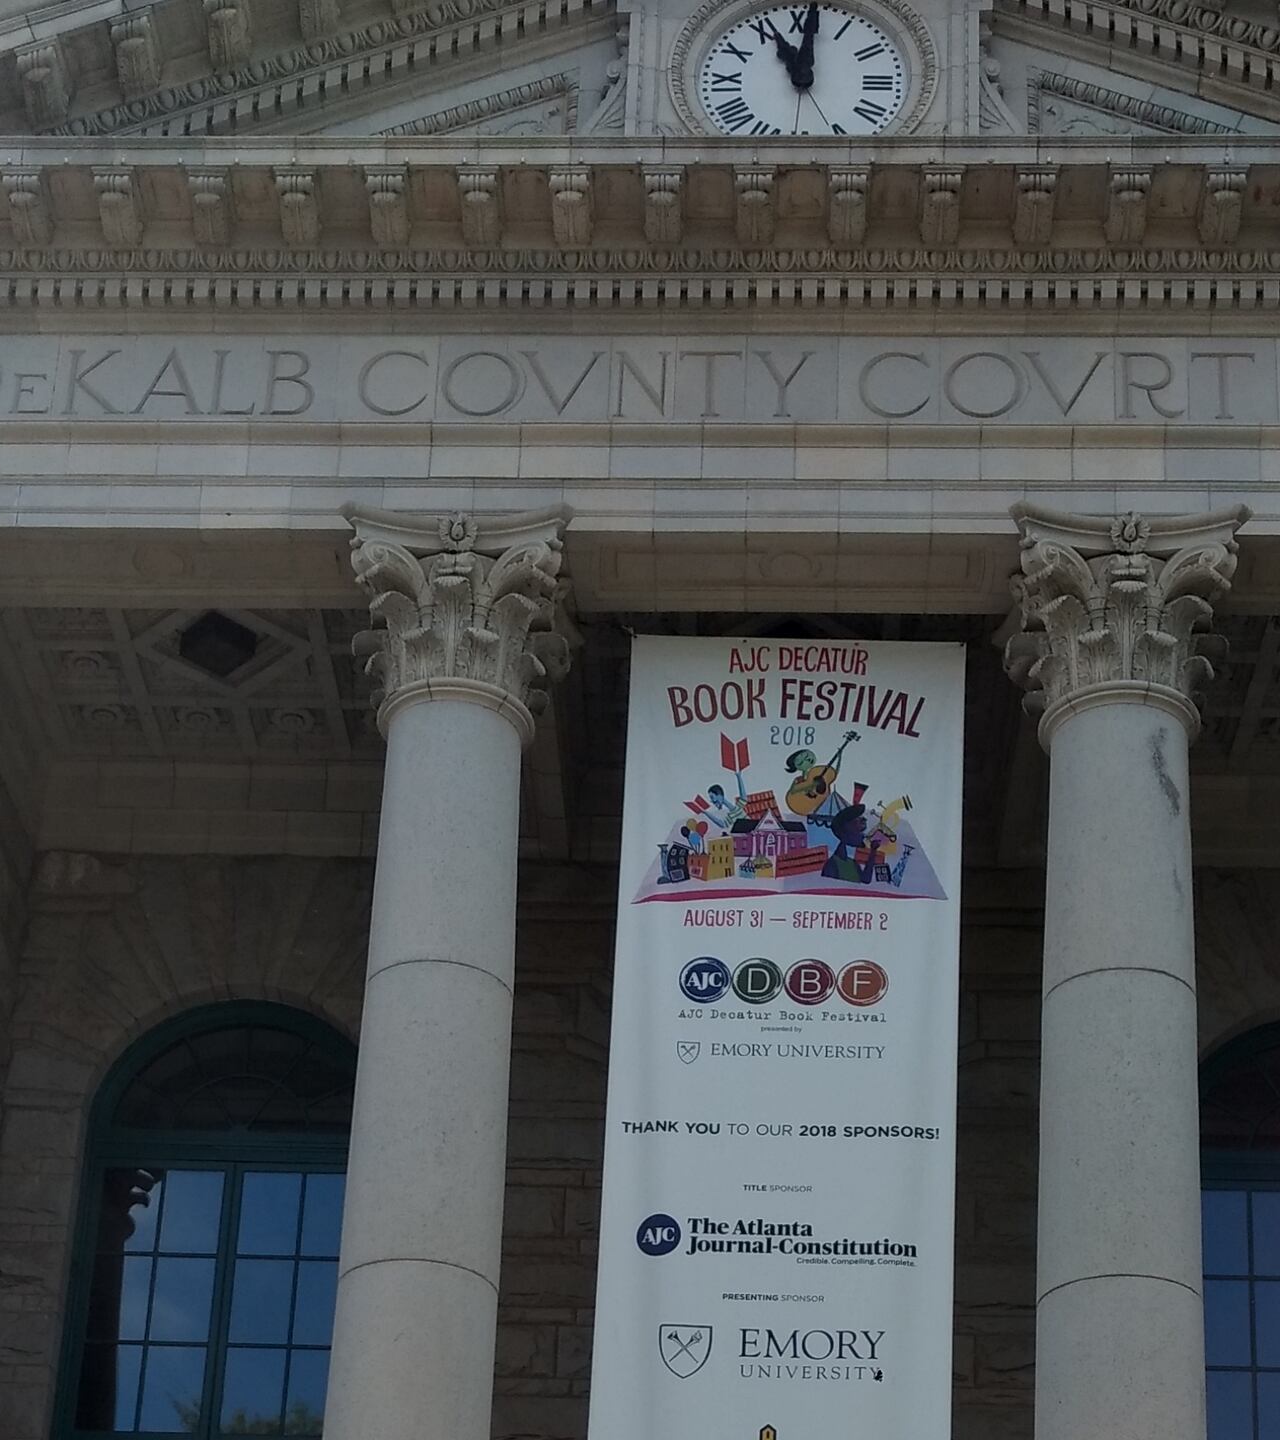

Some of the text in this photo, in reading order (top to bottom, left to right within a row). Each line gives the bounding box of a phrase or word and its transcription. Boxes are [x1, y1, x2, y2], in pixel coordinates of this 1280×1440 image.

[722, 42, 752, 63] X
[854, 43, 885, 62] II
[712, 72, 742, 92] IX
[862, 75, 893, 90] III
[716, 97, 755, 131] VIII
[853, 99, 887, 124] IV
[356, 347, 818, 421] COVNTY
[858, 349, 1256, 422] COVRT
[729, 646, 869, 675] AJC DECATUR
[667, 678, 925, 738] BOOK FESTIVAL
[770, 726, 816, 746] 2018
[683, 909, 888, 931] AUGUST 31 SEPTEMBER 2
[686, 968, 872, 995] AJC D B F
[678, 1009, 887, 1023] AJC Decatur Book Festival
[711, 1043, 886, 1059] EMORY UNIVERSITY
[622, 1120, 939, 1140] THANK YOU TO OUR 2018 SPONSORS!
[743, 1184, 813, 1193] TITLE SPONSOR
[642, 1226, 675, 1246] AJC
[687, 1218, 813, 1237] The Atlanta
[686, 1236, 918, 1257] Journal-Constitution
[722, 1293, 825, 1303] PRESENTING SPONSOR
[739, 1328, 886, 1360] EMORY
[740, 1364, 883, 1381] UNIVERSITY
